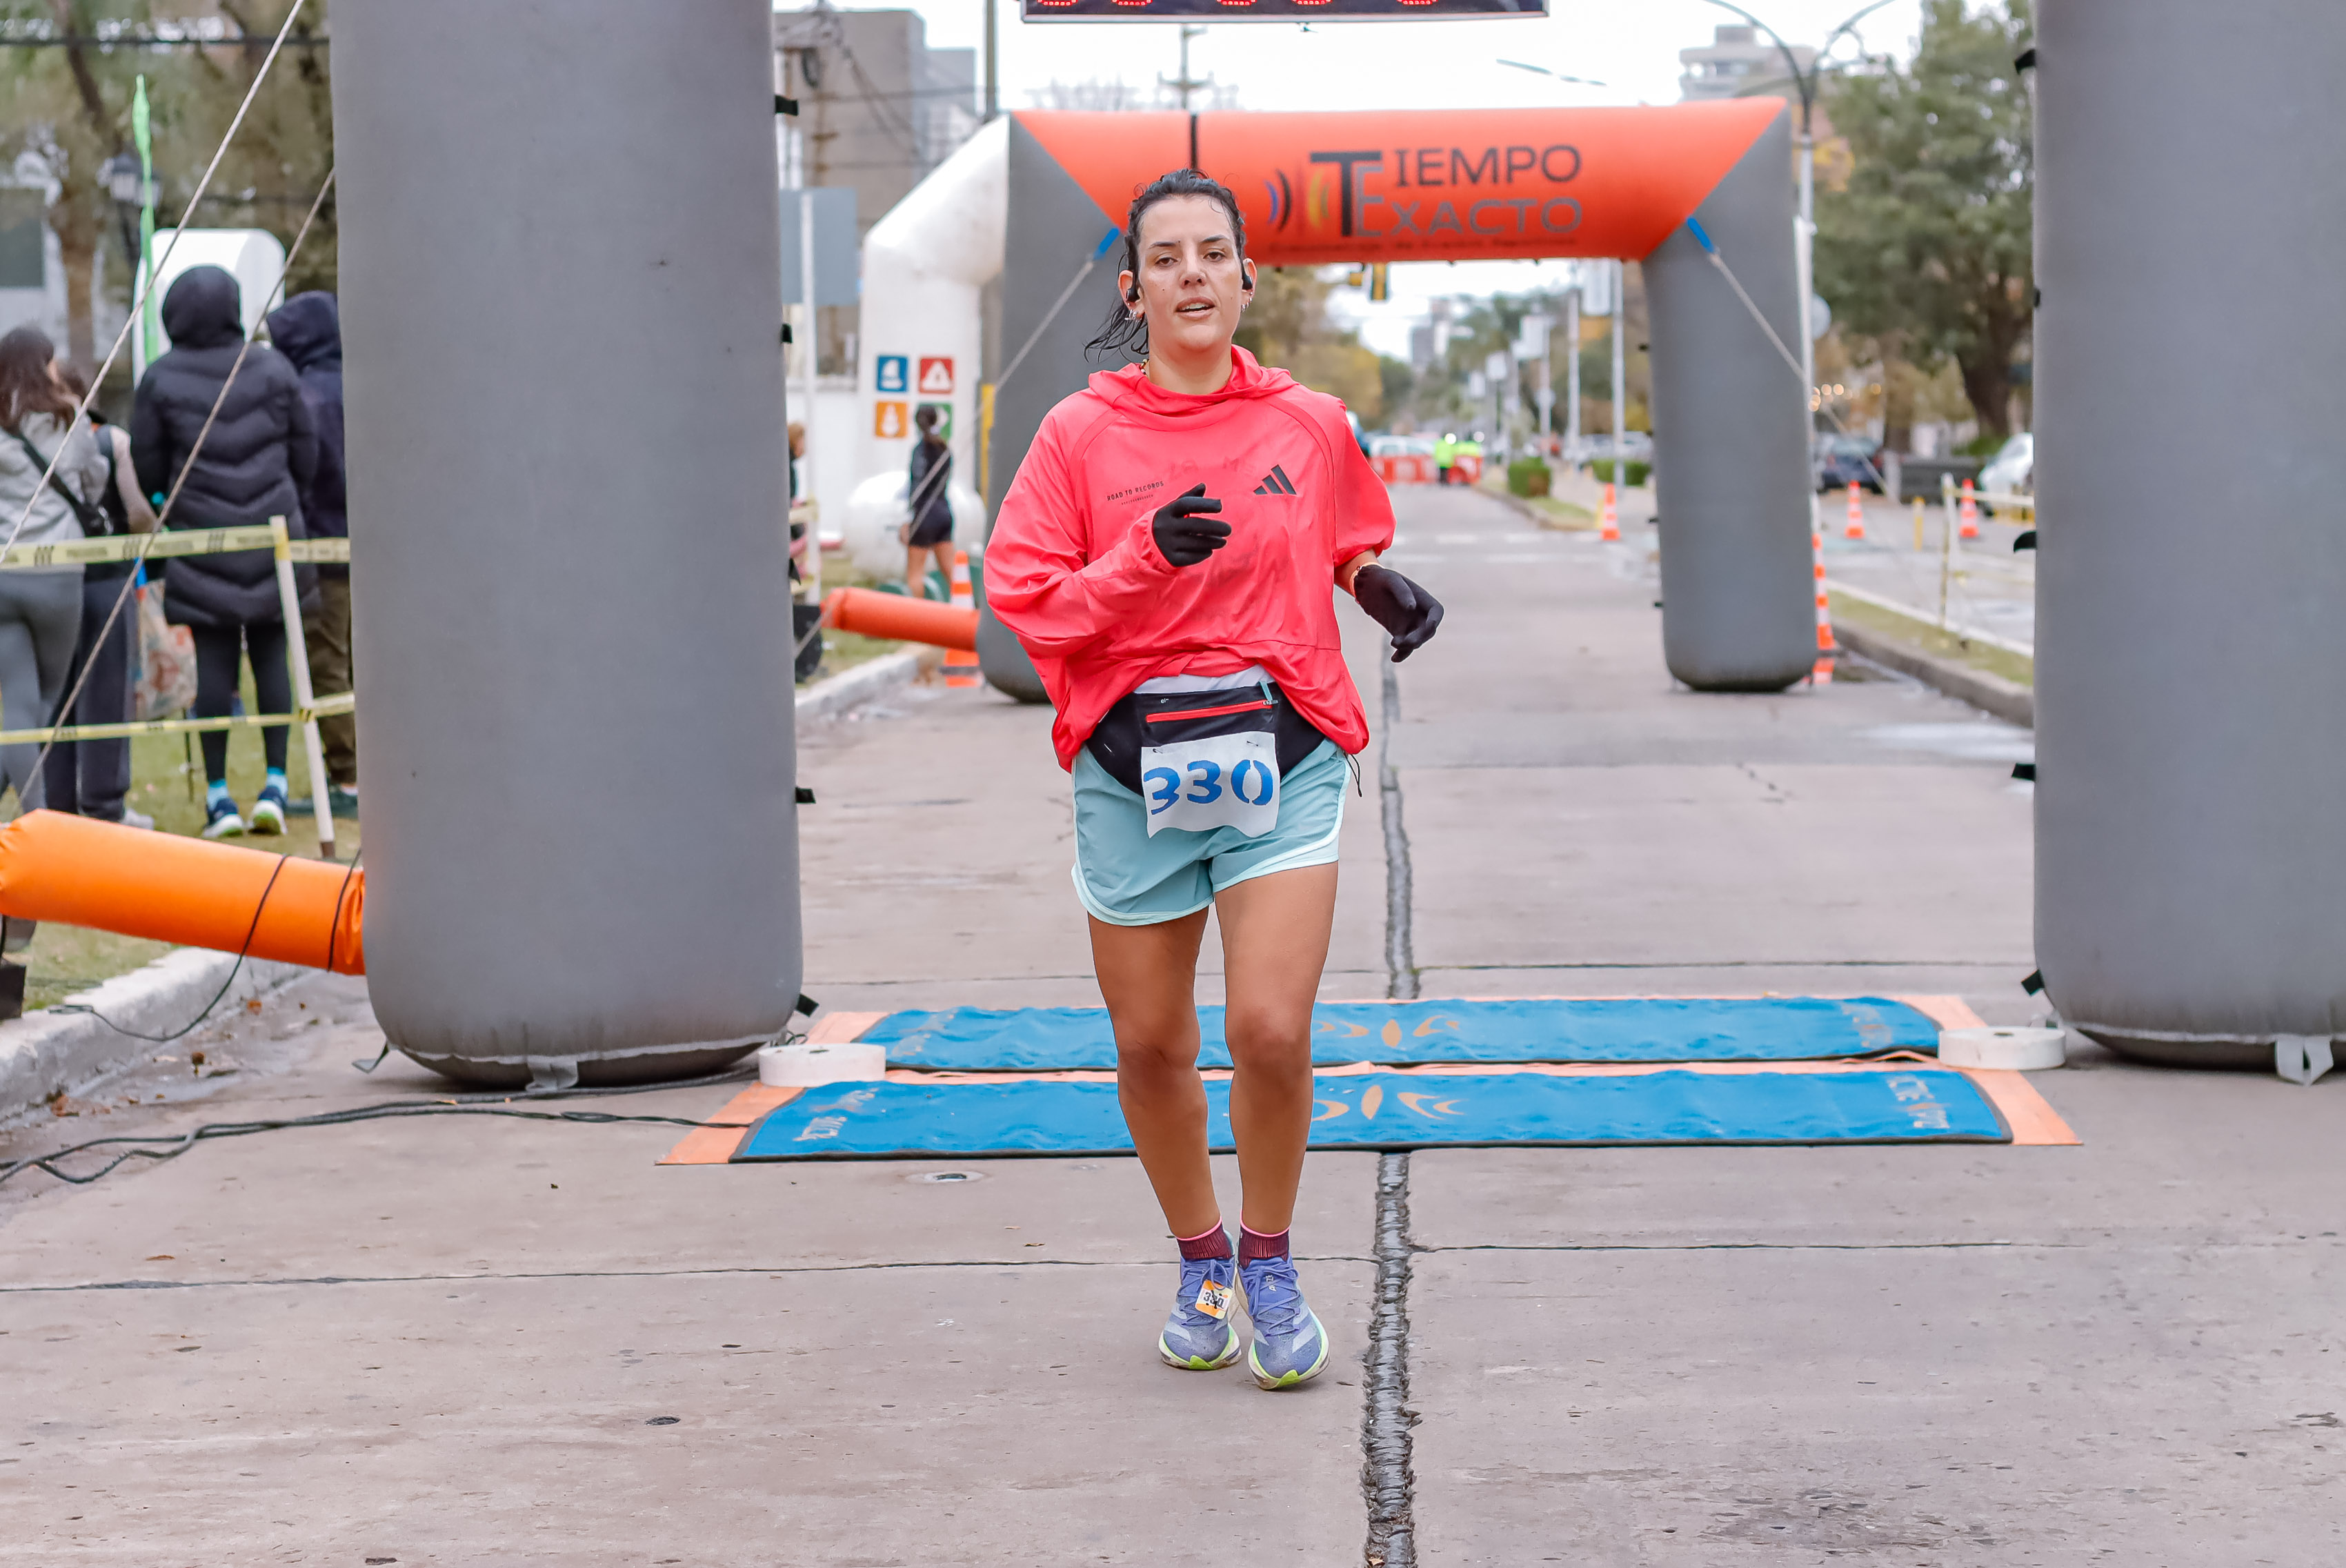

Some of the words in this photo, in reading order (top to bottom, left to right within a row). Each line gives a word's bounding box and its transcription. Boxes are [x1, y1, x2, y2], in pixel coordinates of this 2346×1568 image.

[1310, 143, 1582, 237] TIEMPO
[1106, 491, 1124, 502] ROAD
[1135, 481, 1164, 493] RECORDS
[1143, 759, 1273, 815] 330
